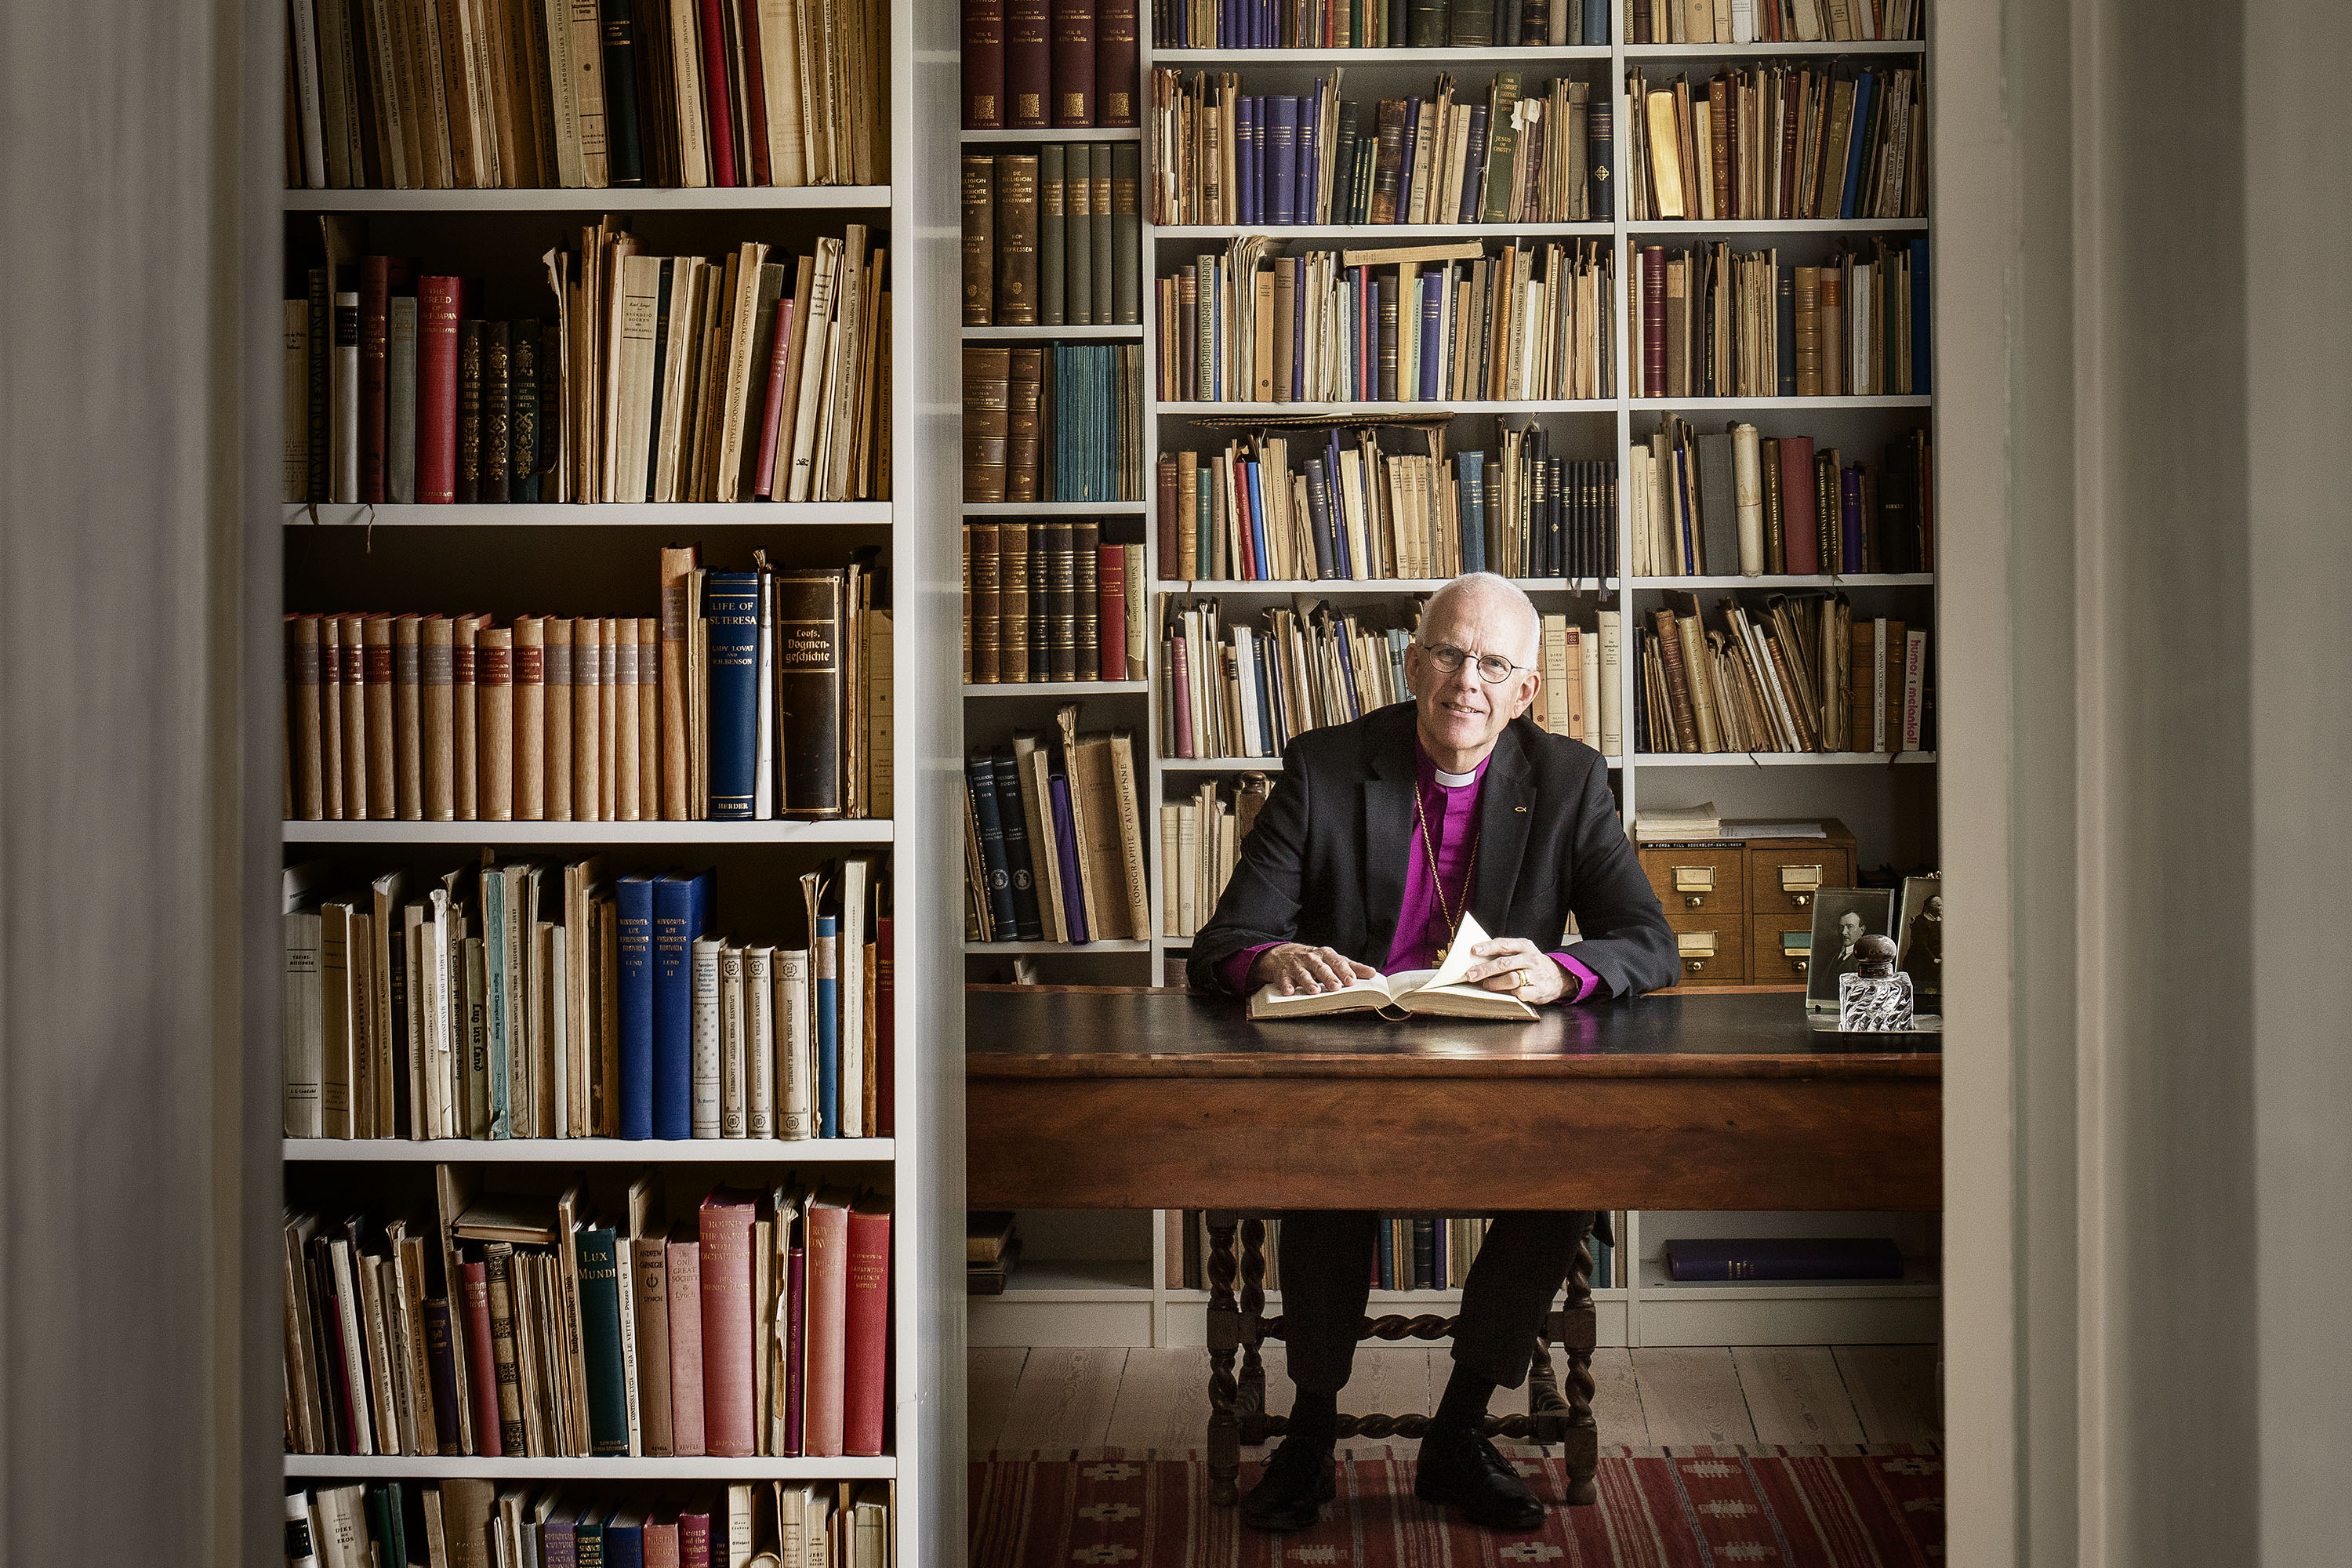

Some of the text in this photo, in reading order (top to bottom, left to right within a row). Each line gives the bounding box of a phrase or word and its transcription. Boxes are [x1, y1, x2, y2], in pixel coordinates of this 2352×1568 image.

[735, 350, 744, 384] GREKISKA
[712, 602, 754, 611] LIFE OF
[722, 615, 757, 626] TERESA
[1907, 639, 1921, 744] humor melankoli
[1120, 764, 1141, 907] ICONOGRAPHIE CALVINIENNE
[471, 1004, 483, 1023] Lug
[473, 1046, 484, 1072] Land
